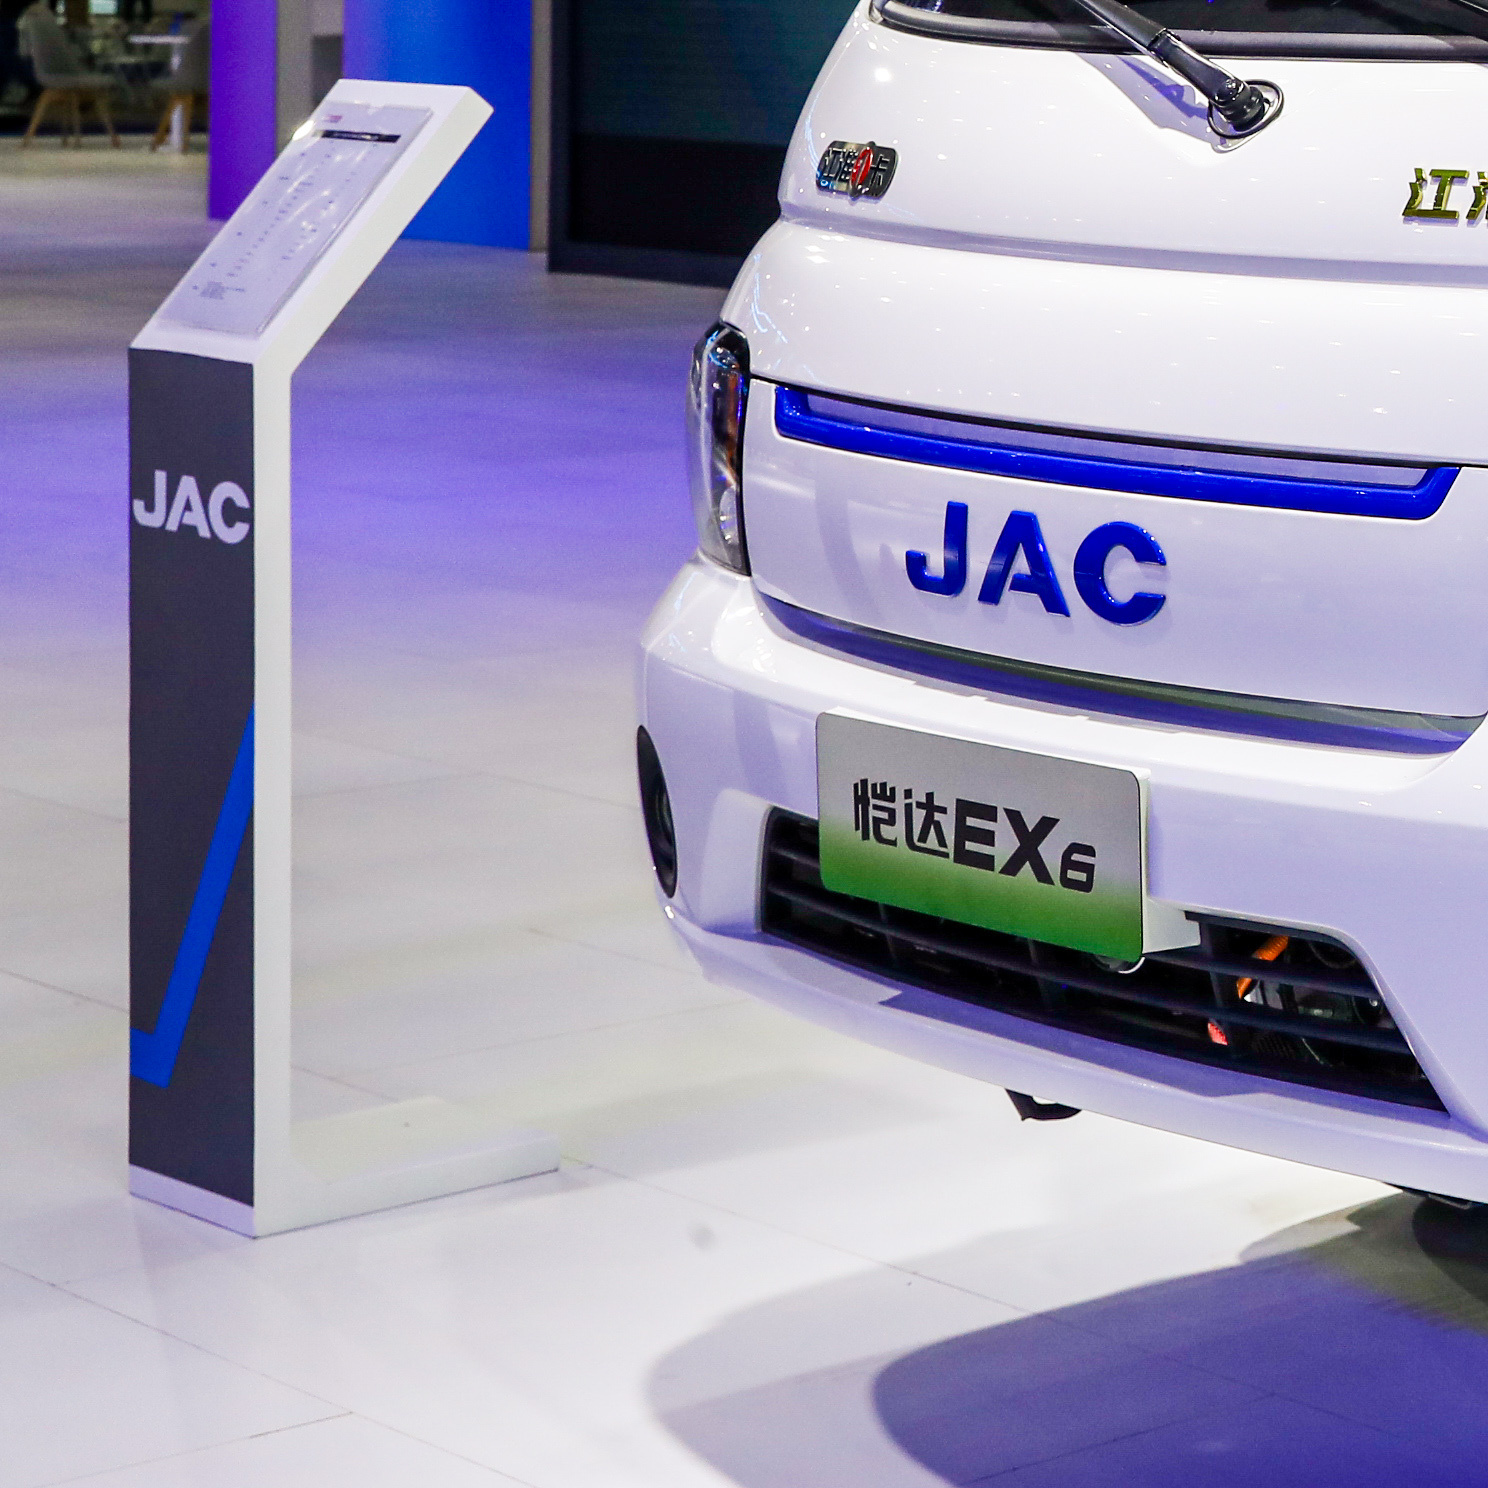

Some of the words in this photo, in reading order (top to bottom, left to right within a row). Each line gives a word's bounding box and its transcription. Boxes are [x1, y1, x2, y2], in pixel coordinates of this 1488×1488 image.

[132, 469, 251, 545] JAC
[905, 500, 1167, 627] JAC
[853, 777, 1097, 894] 恺达EX6
